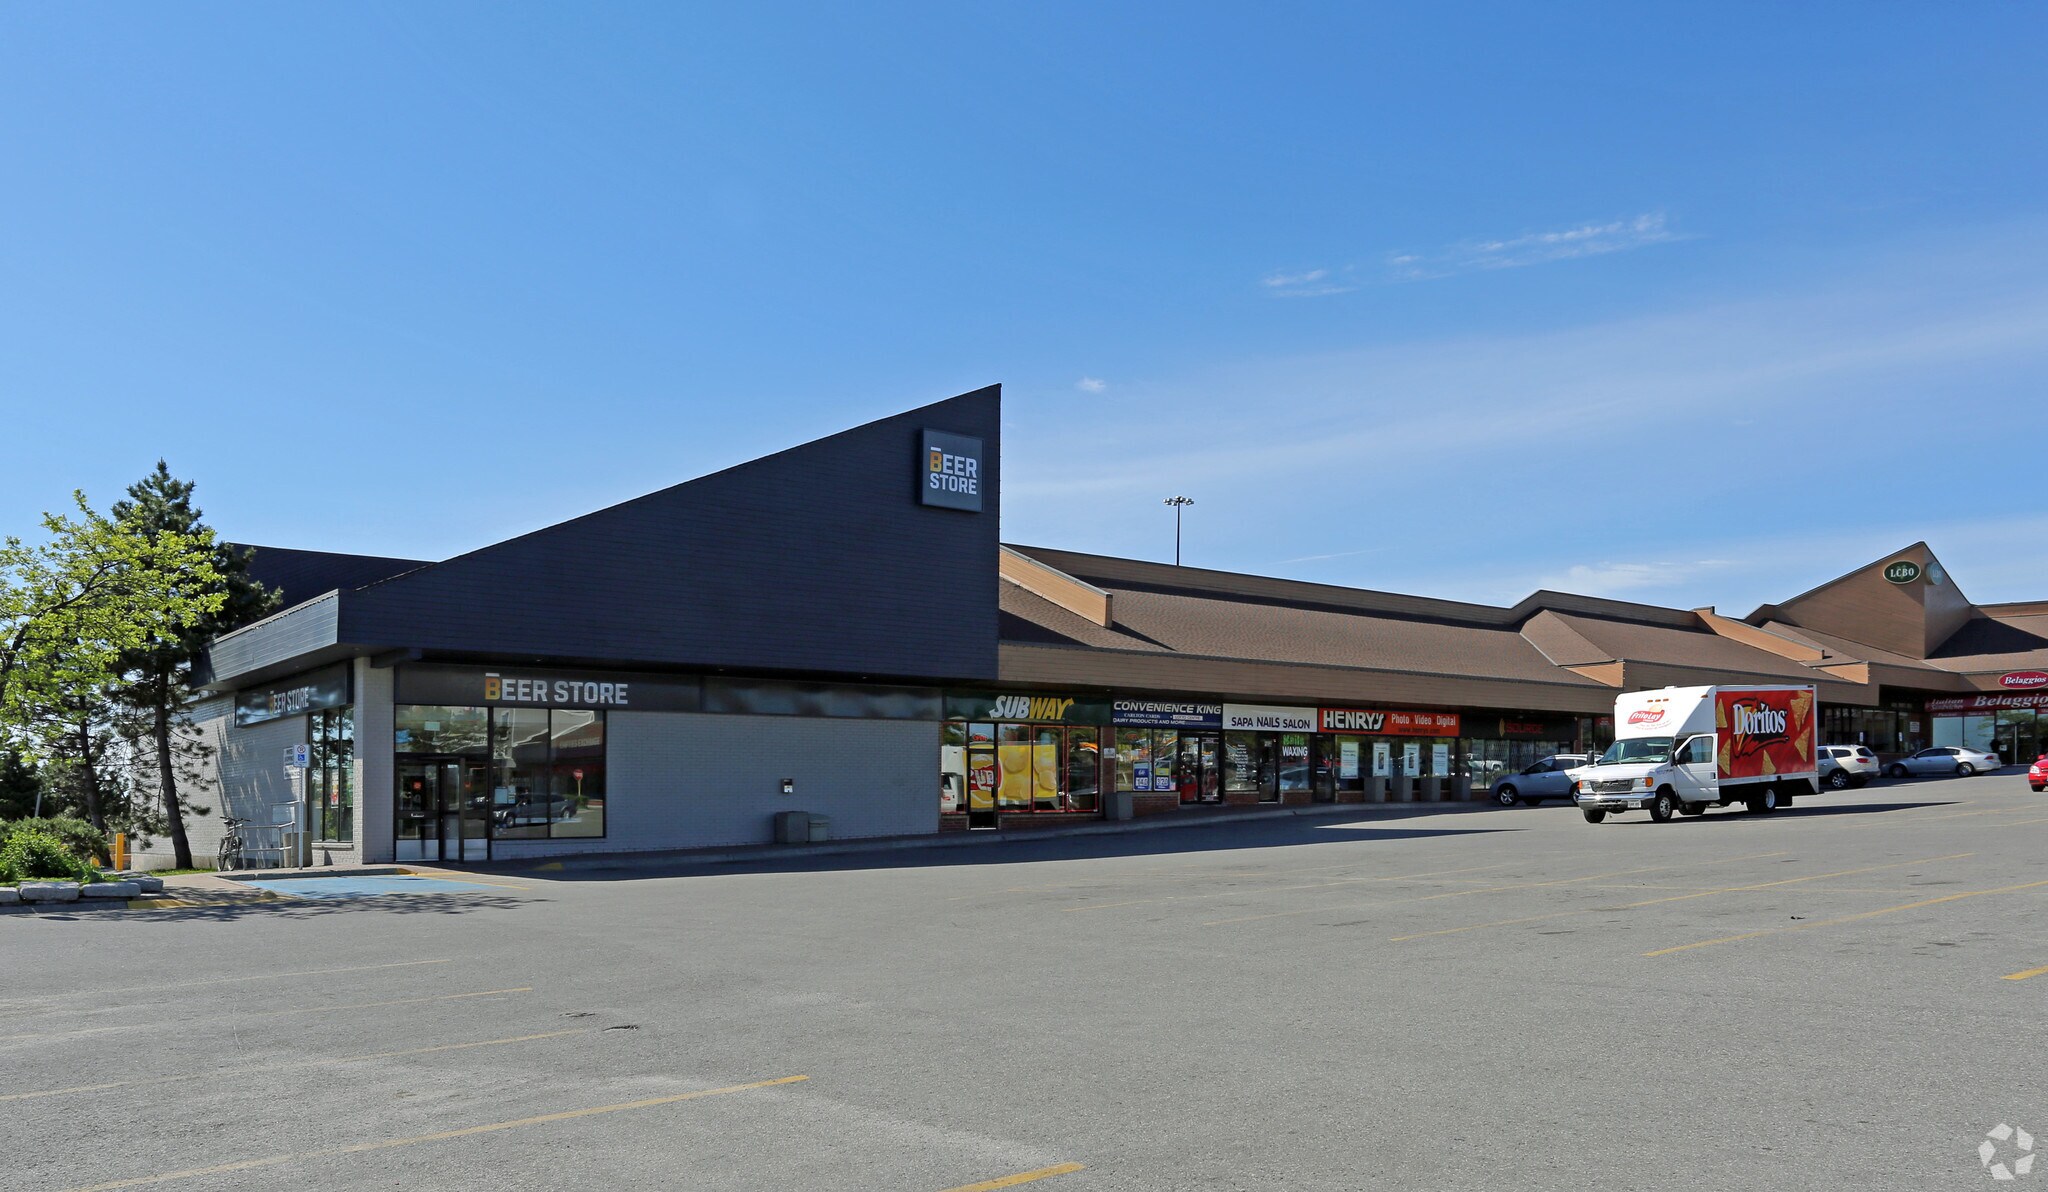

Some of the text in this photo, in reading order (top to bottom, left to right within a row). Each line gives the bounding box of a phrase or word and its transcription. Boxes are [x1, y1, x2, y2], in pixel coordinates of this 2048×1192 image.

[930, 447, 977, 478] BEER
[930, 473, 977, 495] STORE
[1890, 568, 1914, 577] LCBO
[485, 673, 628, 704] BEER STORE
[2004, 675, 2047, 685] Belaggios
[287, 686, 309, 711] STORE
[989, 695, 1074, 720] SUBWAY
[1113, 701, 1221, 715] CONVENIENCE KING
[1231, 717, 1310, 729] SAPA NAILS SALON
[1391, 713, 1456, 727] Photo Video Digital
[1733, 703, 1786, 734] Doritos
[1282, 746, 1308, 757] WAXING
